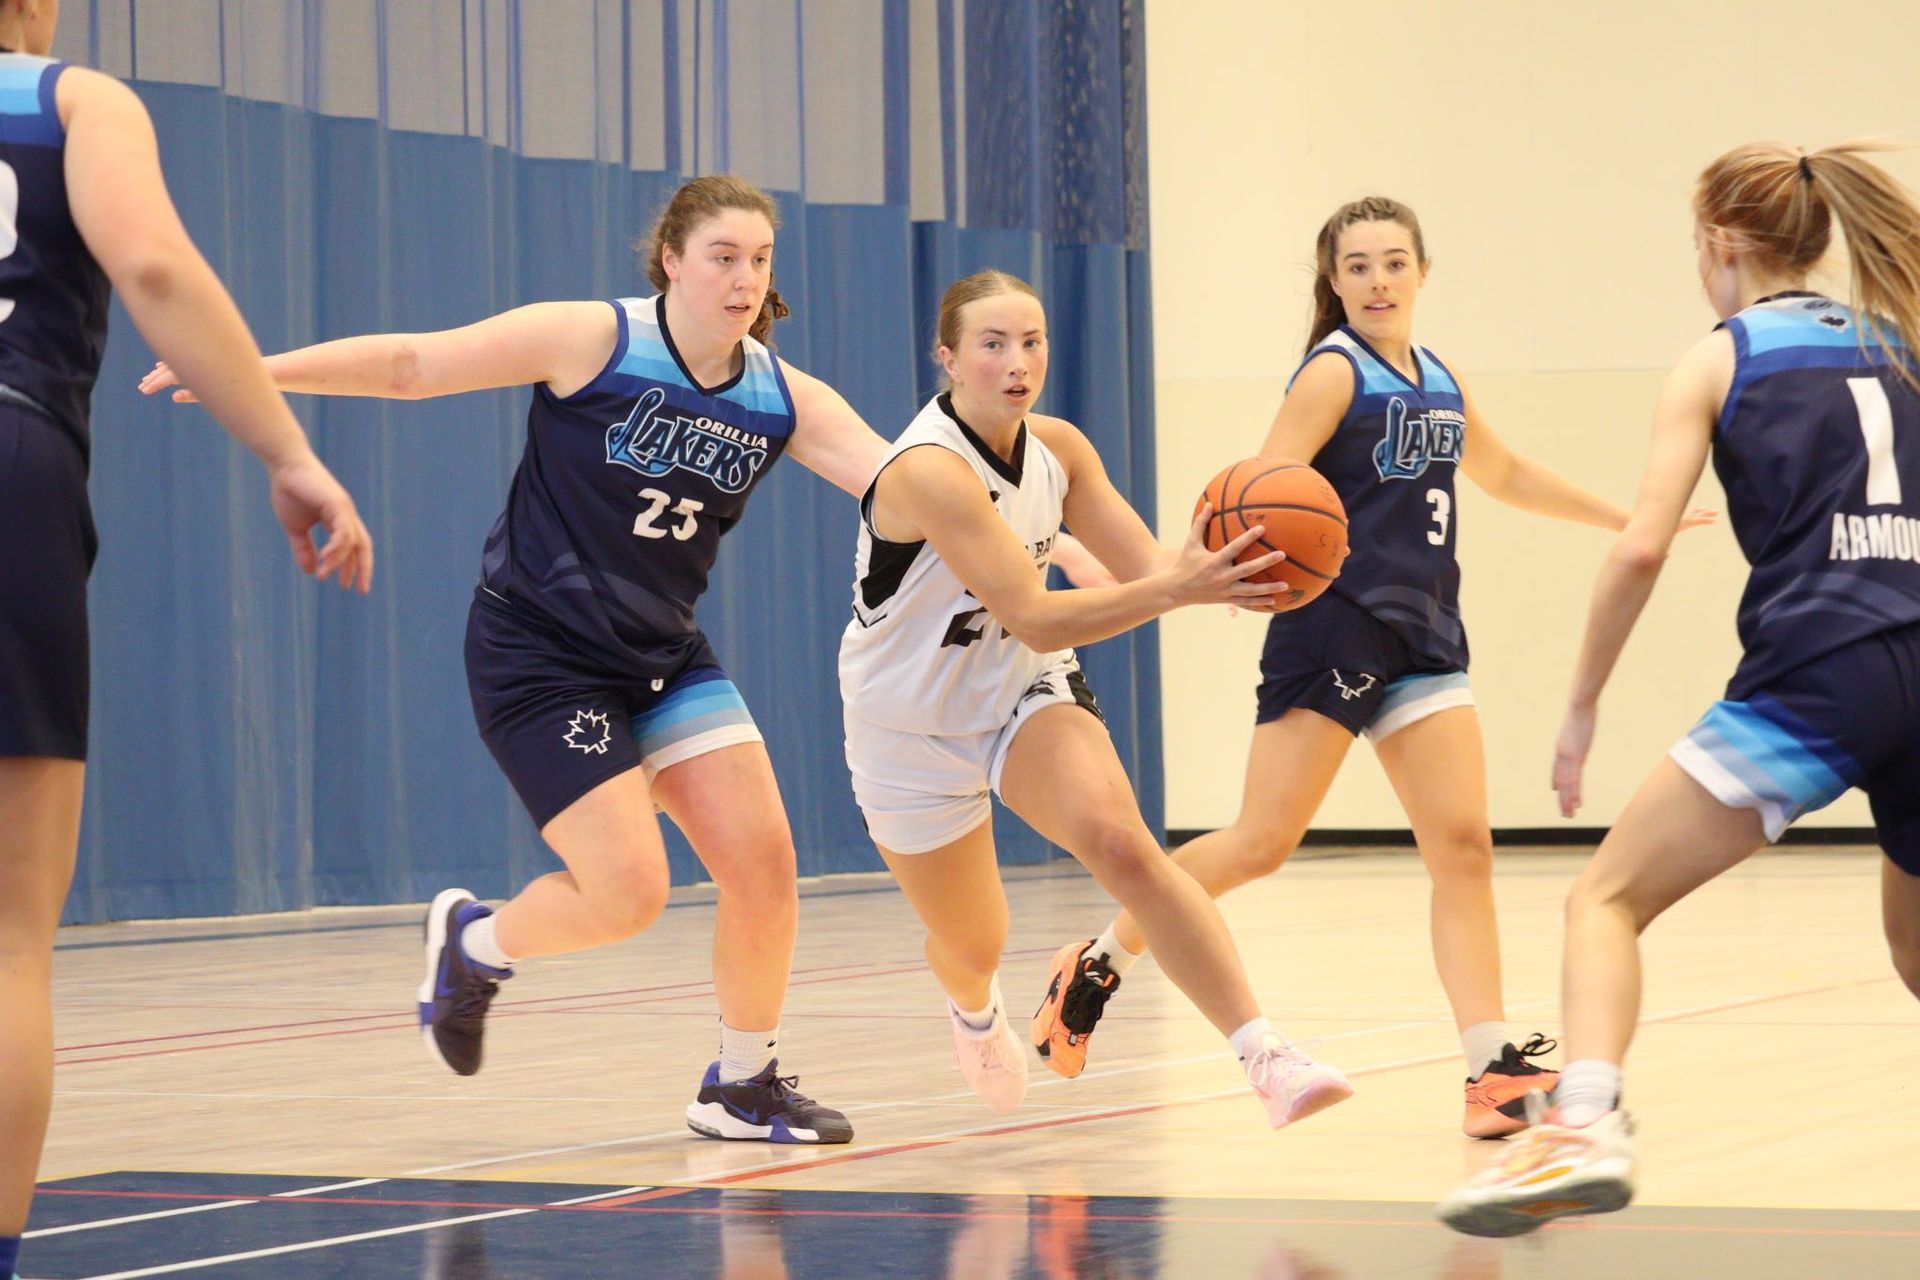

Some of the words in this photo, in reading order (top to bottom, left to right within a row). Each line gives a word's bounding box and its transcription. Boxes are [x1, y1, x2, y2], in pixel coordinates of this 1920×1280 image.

[605, 387, 768, 494] LAKERS
[694, 416, 768, 450] ORILLIA
[1372, 396, 1466, 483] LAKER
[1846, 376, 1902, 506] 1
[632, 487, 704, 541] 25
[1425, 487, 1451, 546] 3
